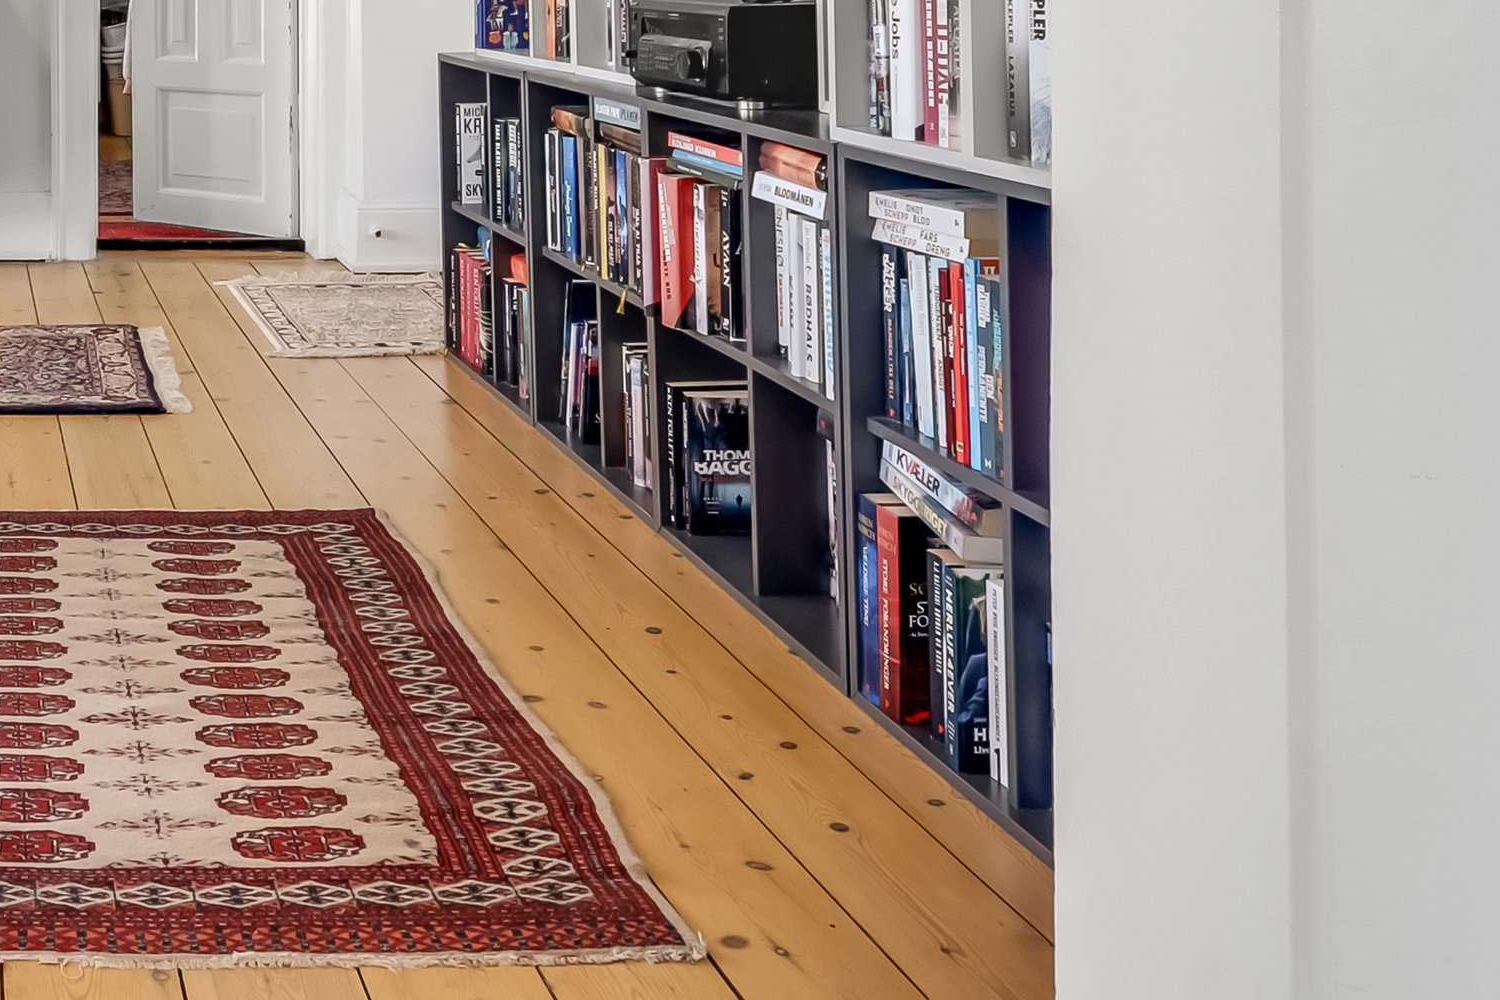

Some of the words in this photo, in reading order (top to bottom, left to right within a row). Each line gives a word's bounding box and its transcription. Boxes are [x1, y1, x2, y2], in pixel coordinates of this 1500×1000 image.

[891, 11, 902, 60] Jobs
[1008, 55, 1016, 118] LAZARUS
[773, 185, 815, 208] BLODMÅNEN
[875, 196, 898, 209] EMELIE
[883, 208, 909, 221] SCHEPP
[912, 214, 931, 226] BLOD
[881, 221, 907, 235] EMELIE
[889, 233, 917, 247] SCHEPP
[919, 230, 939, 243] FARS
[925, 242, 951, 257] DRENG
[722, 229, 731, 288] AYAAN
[805, 283, 813, 362] RØDHALS
[702, 449, 750, 461] THOM
[694, 460, 751, 475] BAGG
[945, 588, 954, 657] HERLUF
[882, 597, 890, 691] FORANDRINGER
[947, 658, 955, 713] 4EVER
